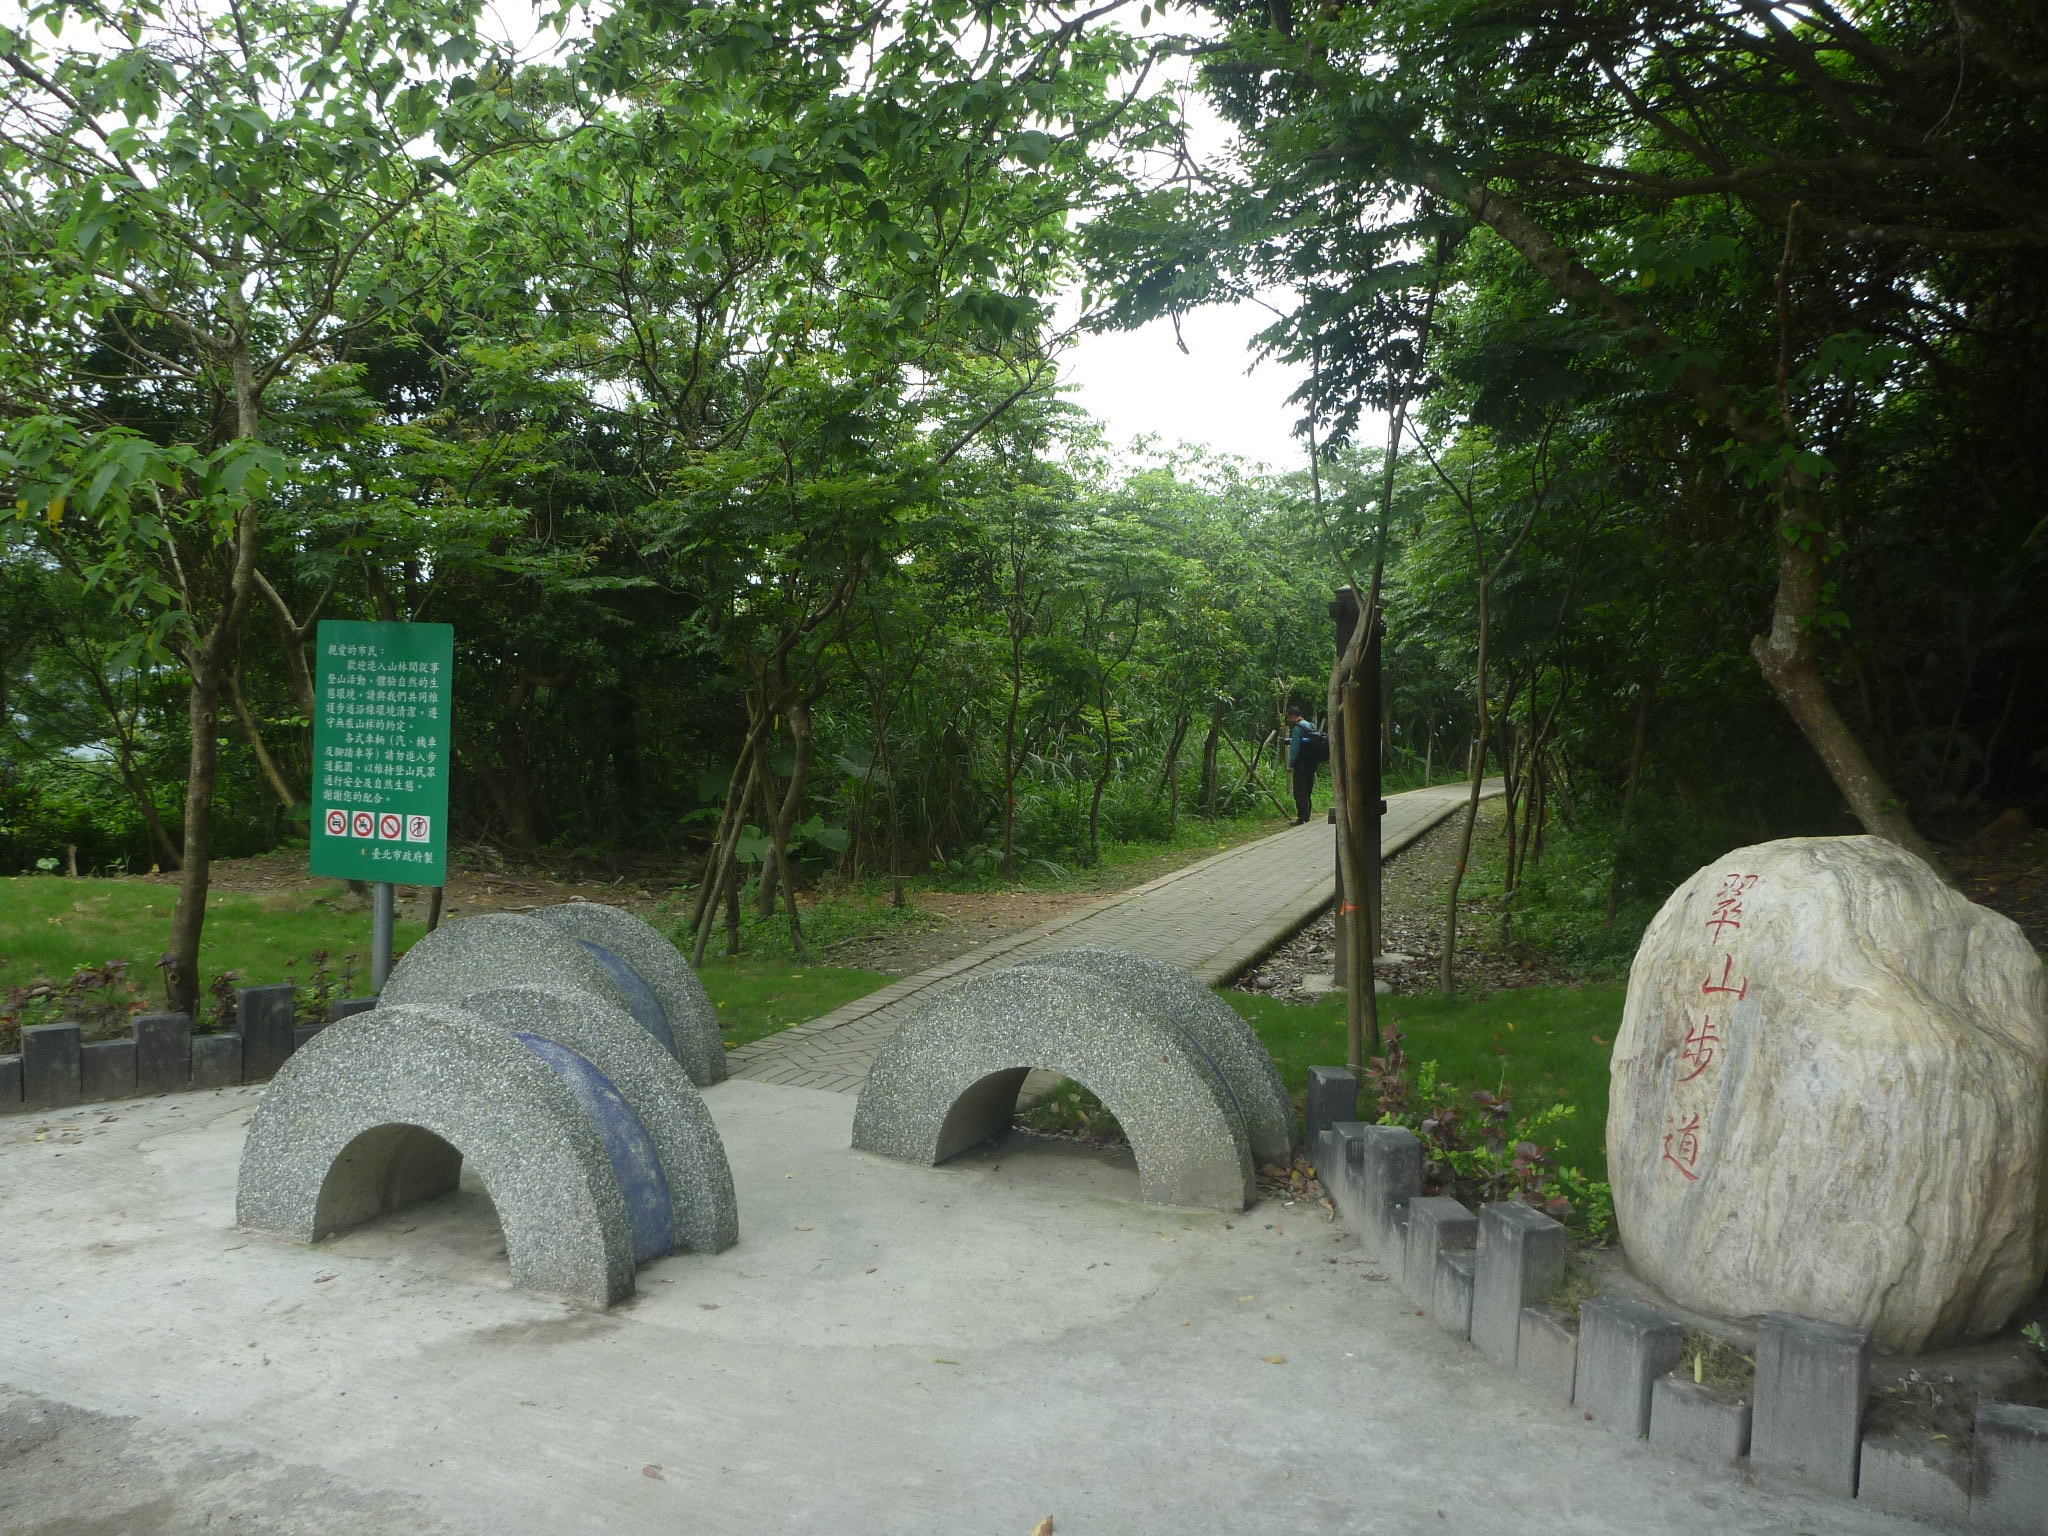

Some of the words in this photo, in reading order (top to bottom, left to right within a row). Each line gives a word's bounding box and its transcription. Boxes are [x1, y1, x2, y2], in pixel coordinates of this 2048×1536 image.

[347, 660, 440, 674] 歡迎進入山林間從事
[372, 848, 434, 864] 臺北市政府製
[1663, 874, 1759, 1180] 翠山步道
